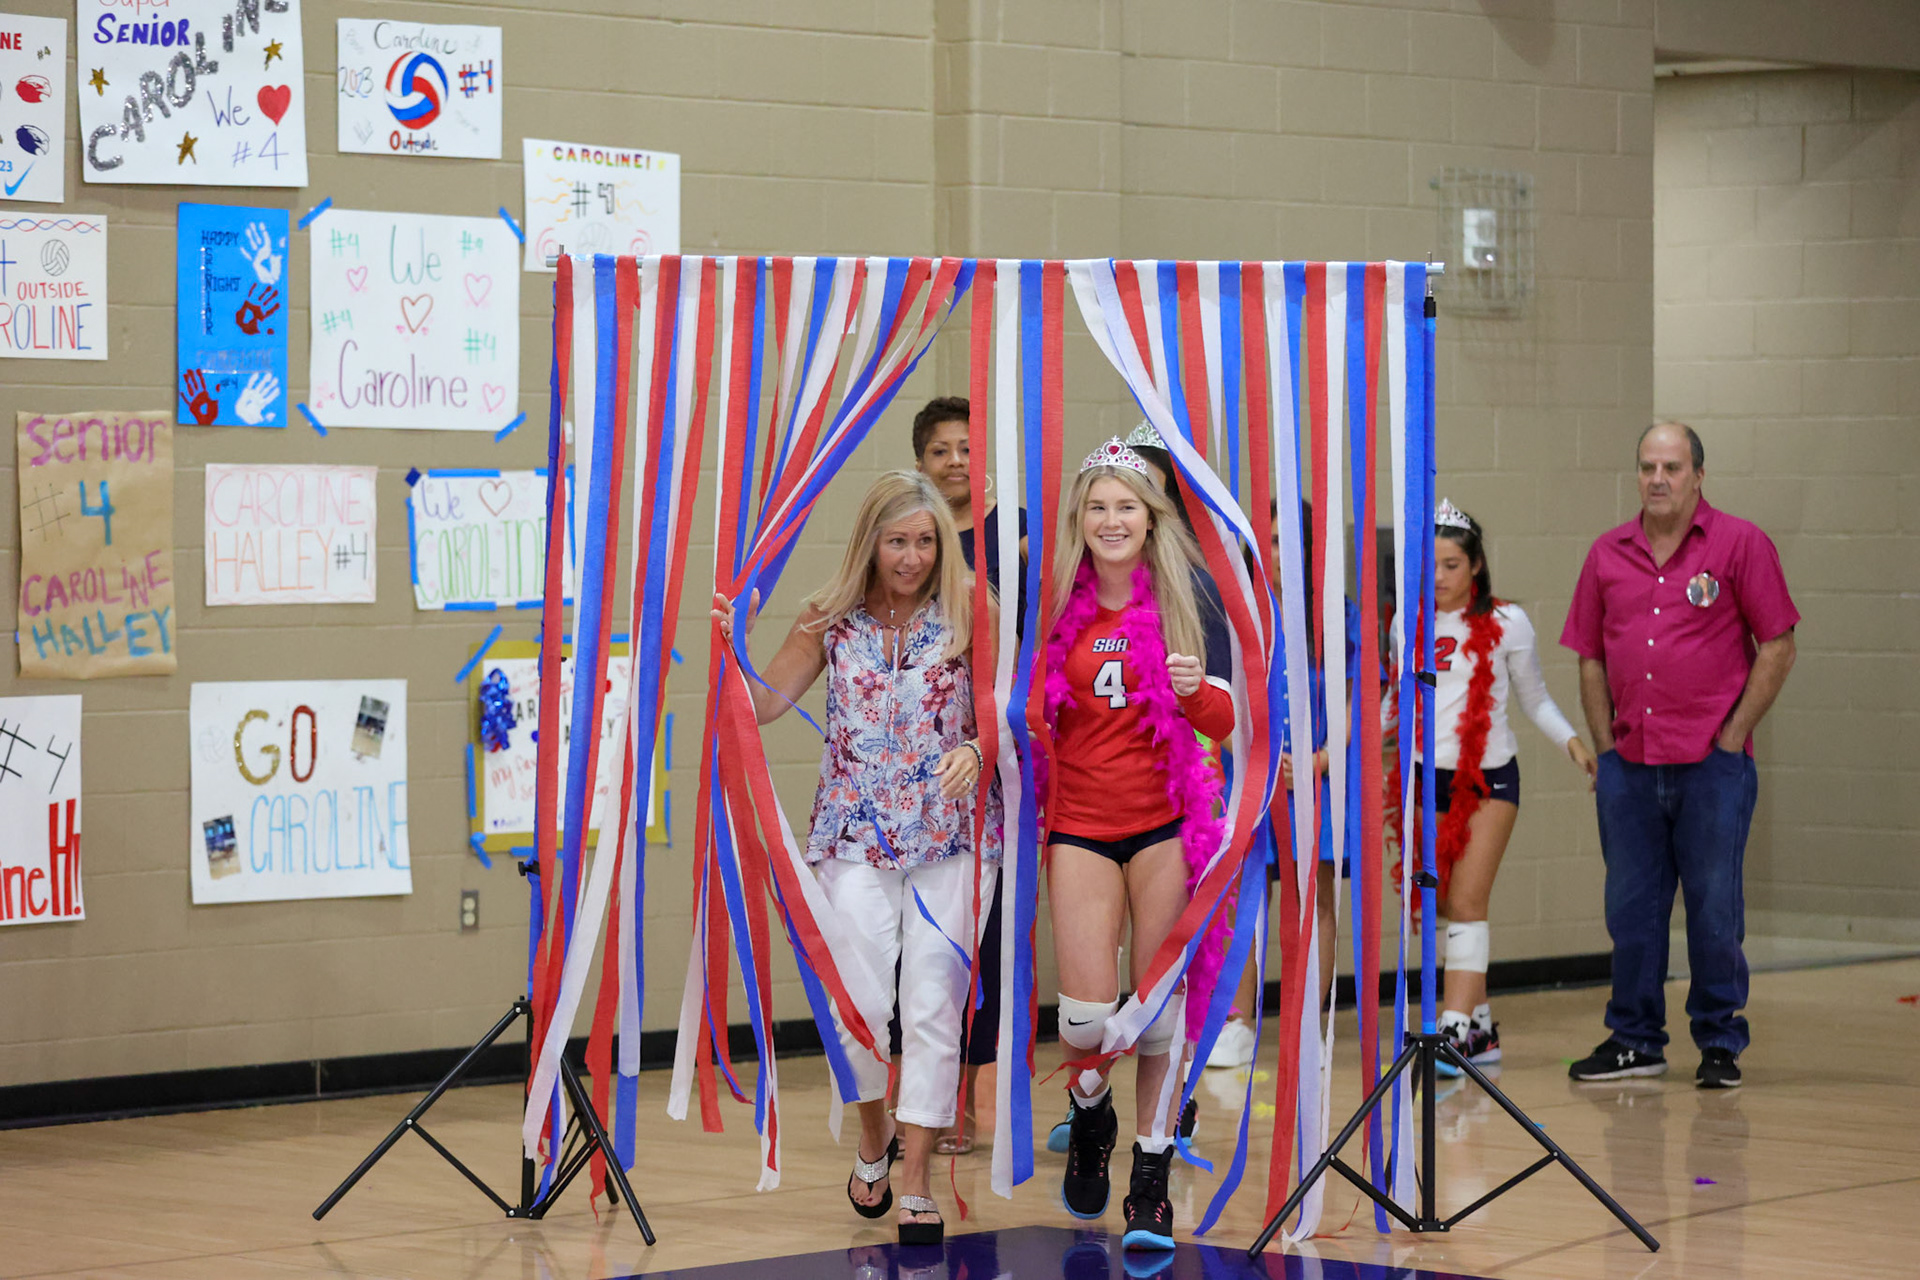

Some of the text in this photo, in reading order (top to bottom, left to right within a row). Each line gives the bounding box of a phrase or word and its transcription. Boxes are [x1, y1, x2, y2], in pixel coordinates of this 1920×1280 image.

[374, 21, 457, 55] Caroline
[458, 59, 493, 99] #4
[207, 85, 250, 127] We
[232, 131, 289, 171] #4
[553, 146, 651, 171] CAROLINE!
[201, 230, 240, 246] HAPPY
[330, 227, 361, 259] #4
[390, 224, 442, 285] We
[17, 281, 89, 301] OUTSIDE
[321, 309, 354, 335] #4
[463, 327, 497, 364] #4
[338, 339, 468, 409] Caroline
[211, 471, 366, 527] CAROLINE
[421, 479, 464, 521] We
[213, 527, 368, 594] HALLEY #4
[32, 605, 171, 660] HALLEY
[1092, 638, 1129, 653] SBA
[1093, 660, 1127, 709] 4
[234, 704, 317, 786] GO
[250, 781, 410, 874] CAROLINE
